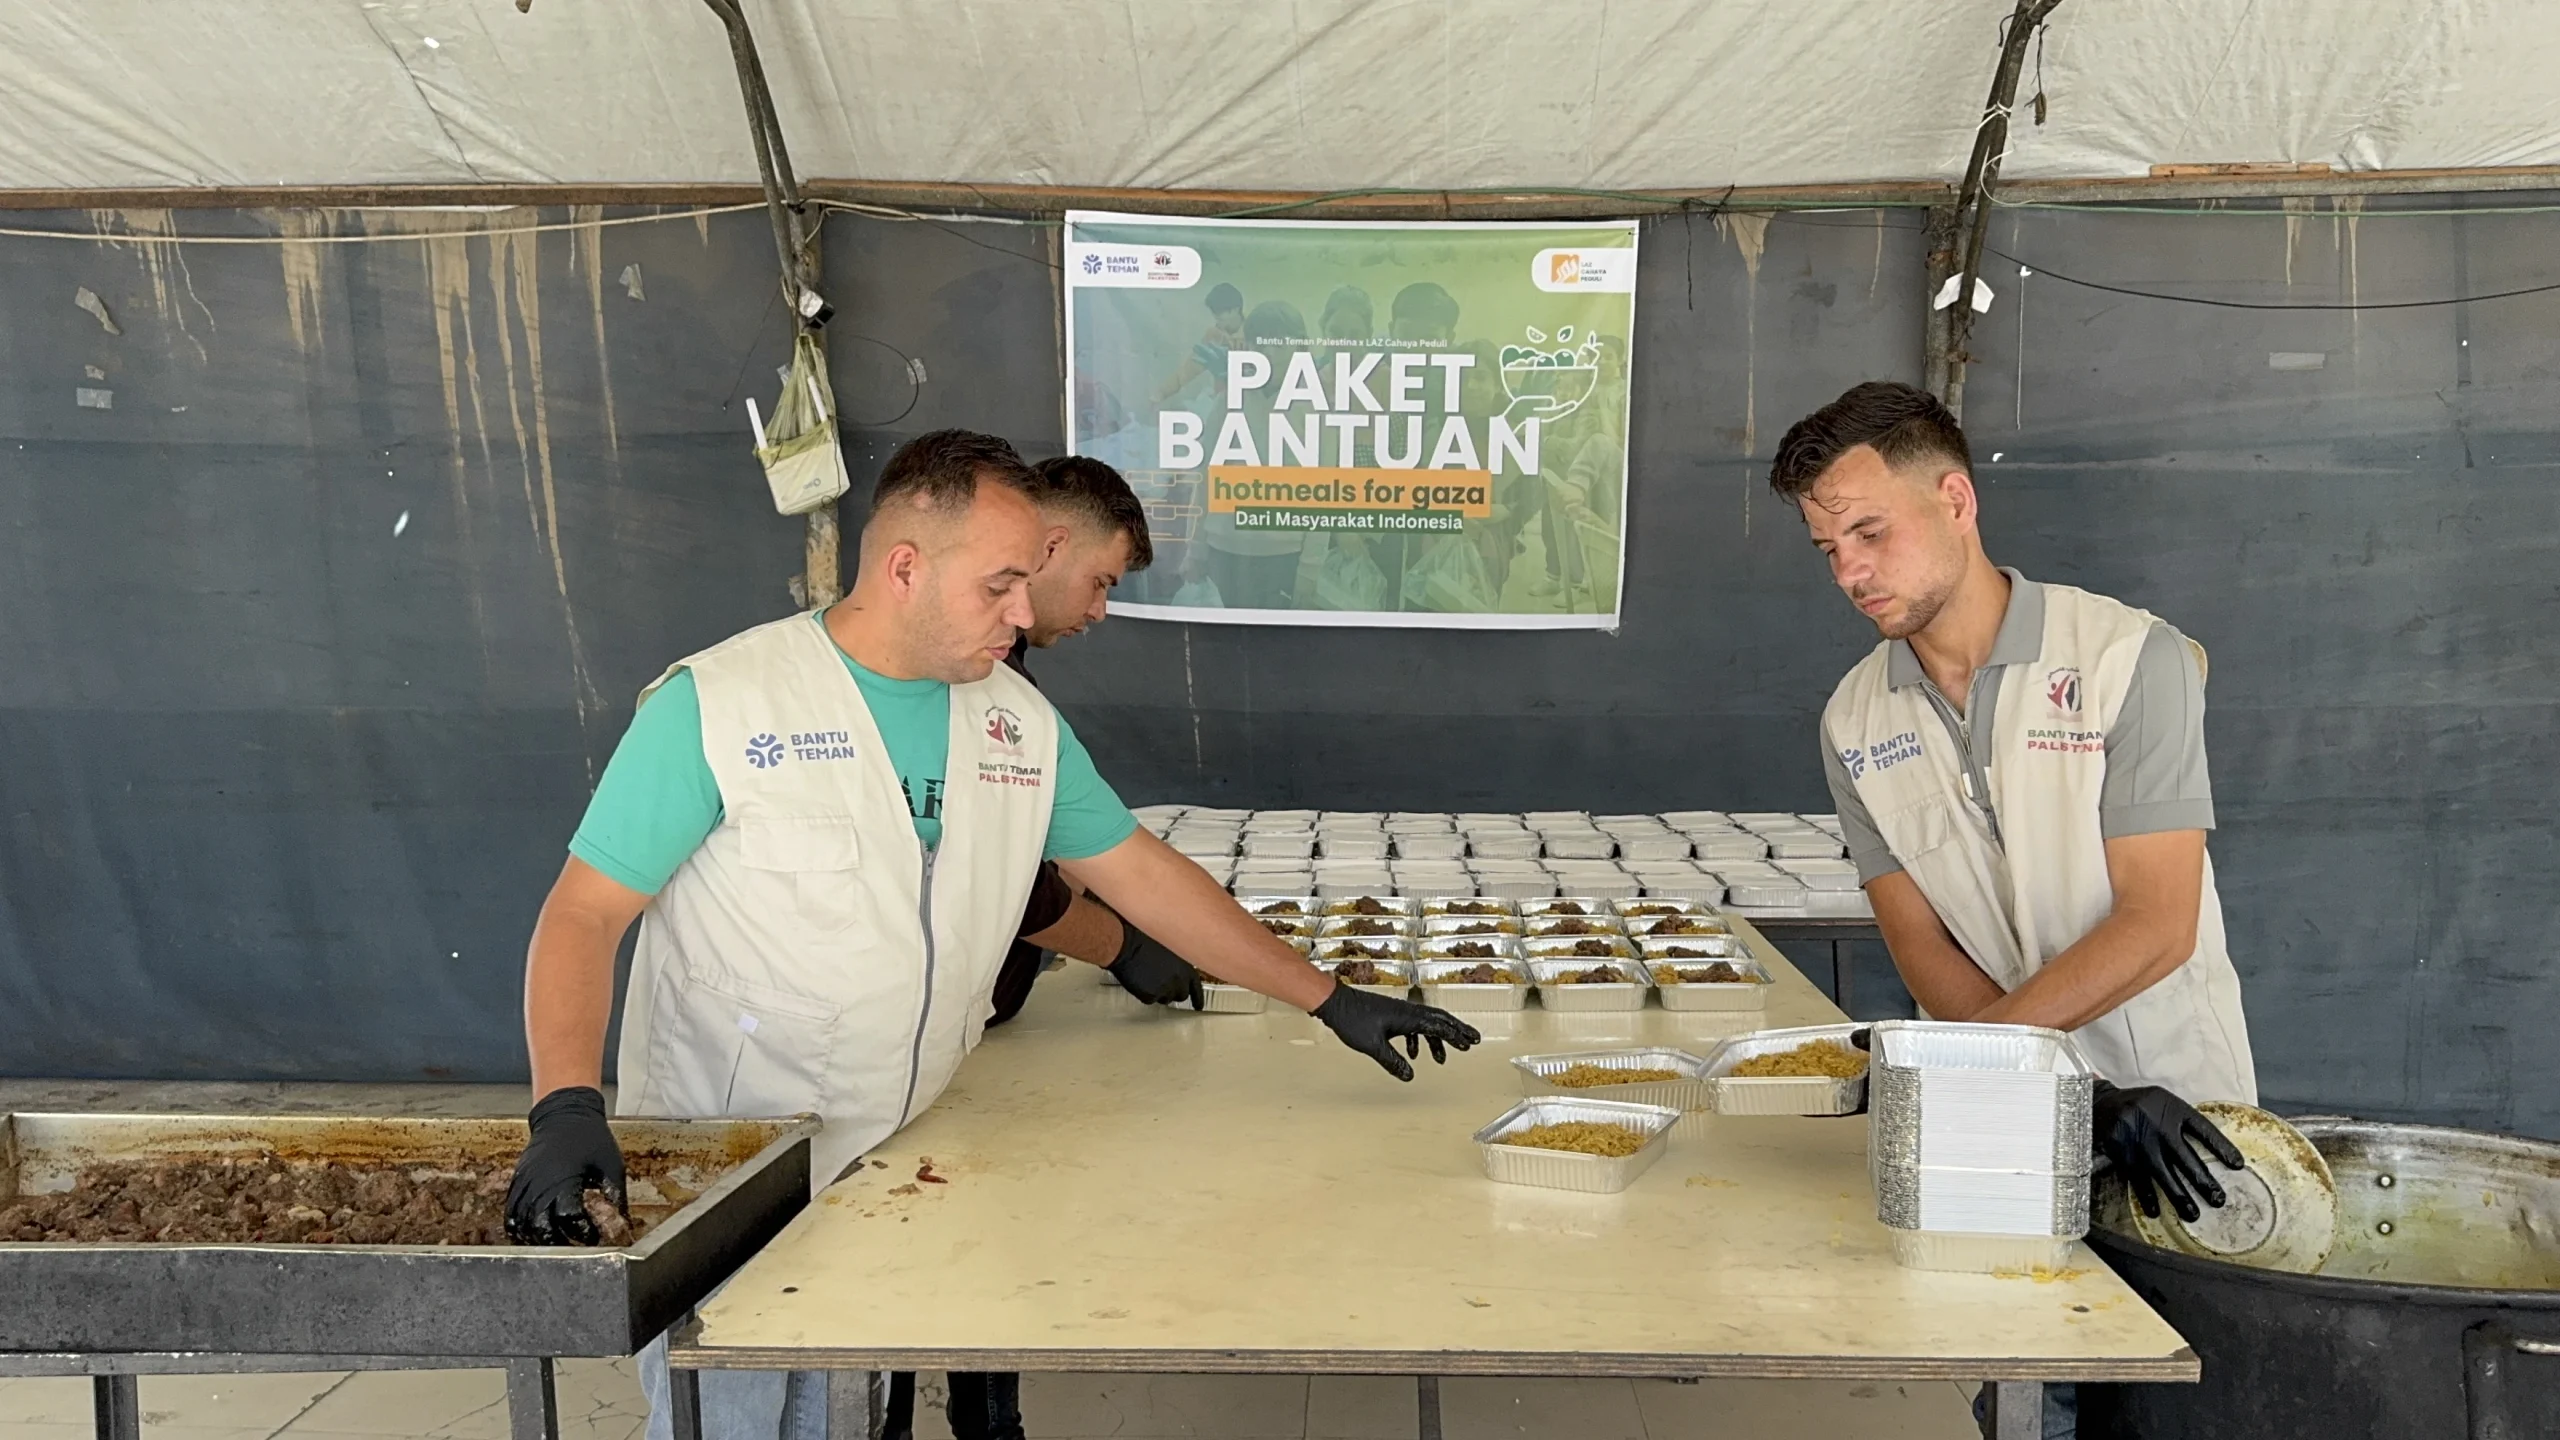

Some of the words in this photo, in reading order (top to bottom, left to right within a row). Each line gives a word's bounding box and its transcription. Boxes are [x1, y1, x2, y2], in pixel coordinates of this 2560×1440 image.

[1107, 256, 1138, 264] BANTU
[1107, 265, 1139, 273] TEMAN
[1256, 337, 1283, 346] Bantu
[1285, 338, 1315, 346] Teman
[1317, 338, 1357, 347] Palestina
[1366, 339, 1383, 347] LAZ
[1385, 339, 1418, 349] Cahaya
[1420, 339, 1448, 348] Peduli
[1227, 351, 1476, 413] PAKET
[1158, 410, 1541, 476] BANTUAN
[1214, 477, 1356, 503] hotmeals
[1364, 479, 1405, 503] for
[1411, 484, 1485, 511] gaza
[1236, 511, 1271, 526] Dari
[1275, 512, 1374, 530] Masyarakat
[1379, 513, 1463, 530] Indonesia
[790, 731, 849, 746] BANTU
[1870, 731, 1916, 757] BANTU
[2027, 740, 2105, 753] PALESTNA
[794, 745, 855, 761] TEMAN
[1872, 744, 1922, 771] TEMAN
